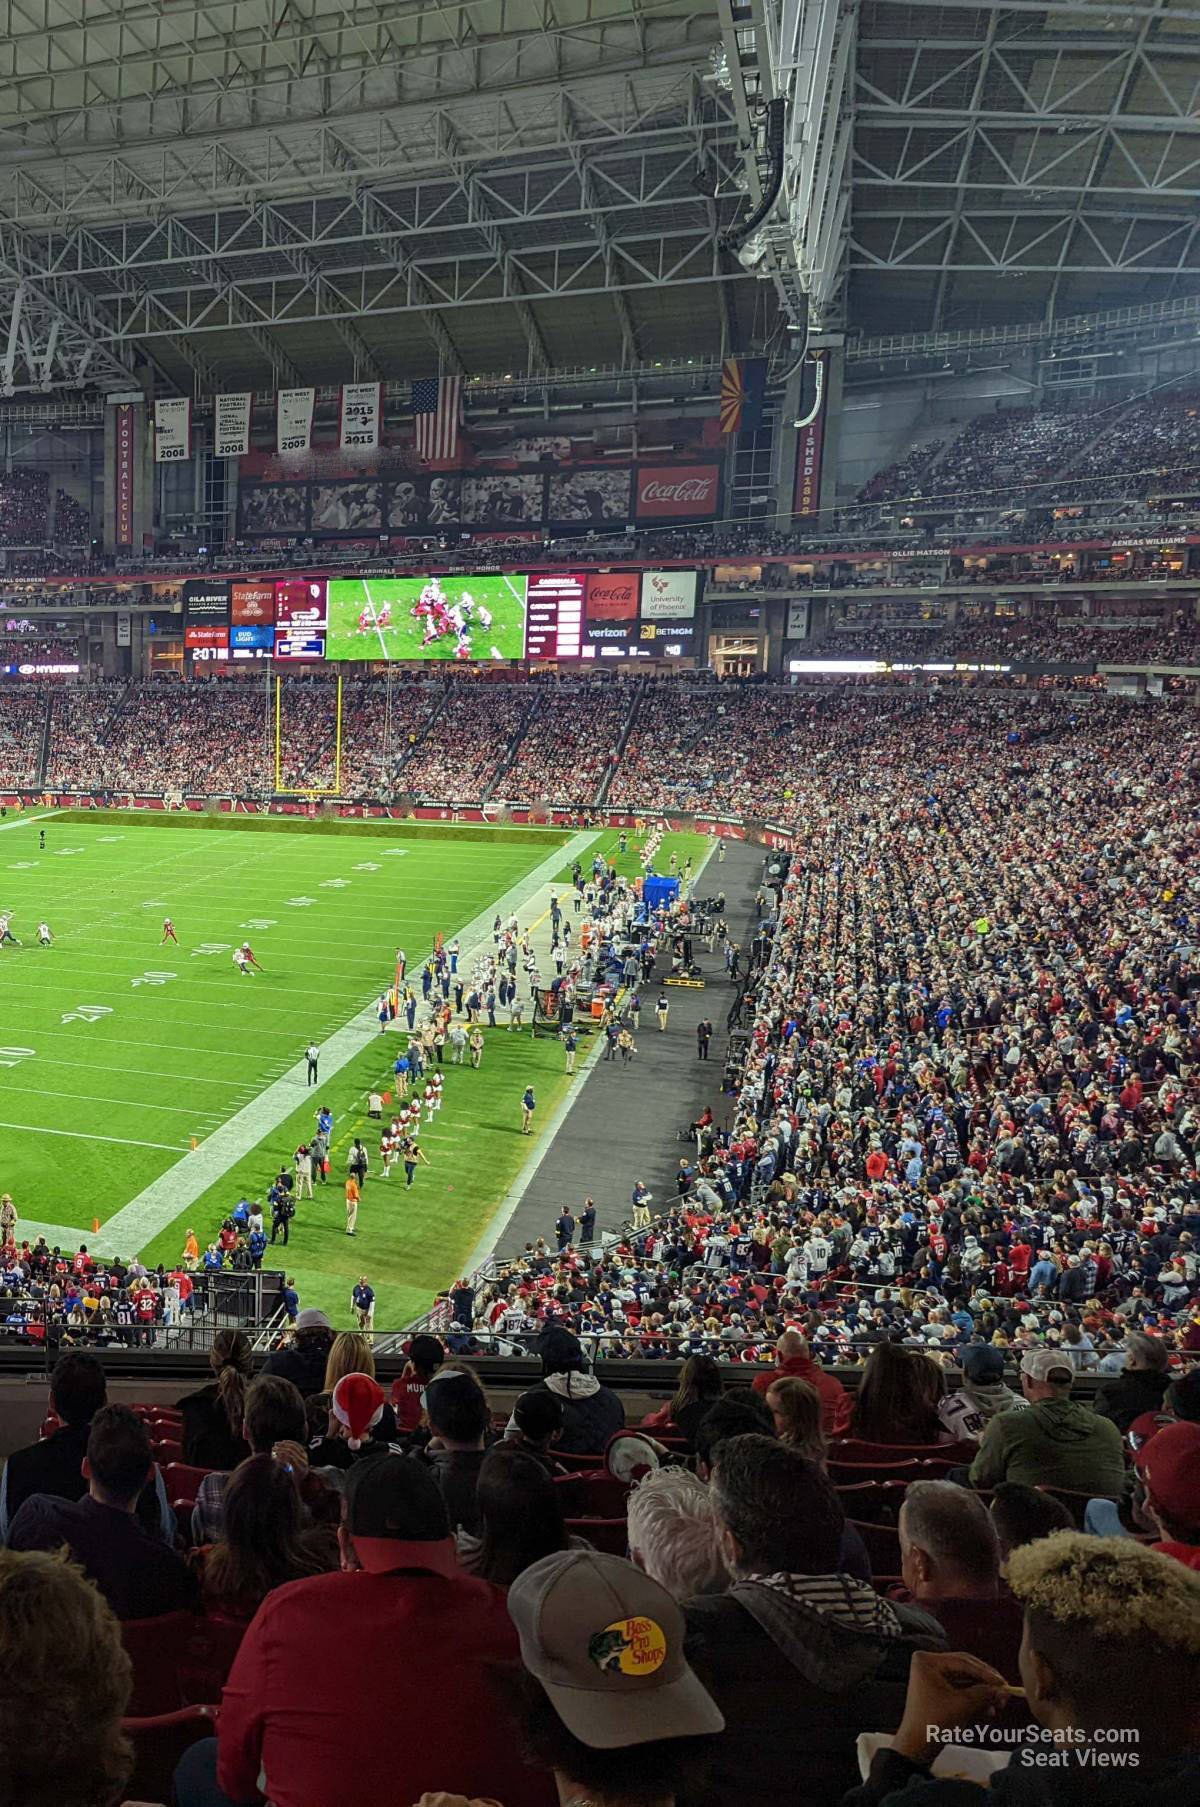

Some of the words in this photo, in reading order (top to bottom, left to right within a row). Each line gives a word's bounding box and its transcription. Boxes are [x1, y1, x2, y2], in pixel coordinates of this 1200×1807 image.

[345, 406, 374, 416] 2015
[281, 440, 306, 450] 2009
[345, 435, 374, 445] 2015
[160, 449, 185, 458] 2008
[219, 444, 244, 454] 2008
[121, 419, 129, 500] FOOTBALL
[121, 503, 129, 542] CLUB
[1112, 538, 1144, 547] AENEAS
[1145, 536, 1187, 545] WILLIAMS
[917, 549, 951, 557] MATSON
[650, 595, 685, 604] University
[588, 628, 627, 638] verizon
[656, 627, 693, 636] BETMGM
[35, 664, 80, 673] HYUNDAI
[131, 971, 178, 987] 30
[61, 1005, 114, 1023] 20
[140, 1299, 152, 1311] 32
[626, 1620, 652, 1637] Bass
[631, 1633, 650, 1650] Pro
[633, 1647, 664, 1665] Shops
